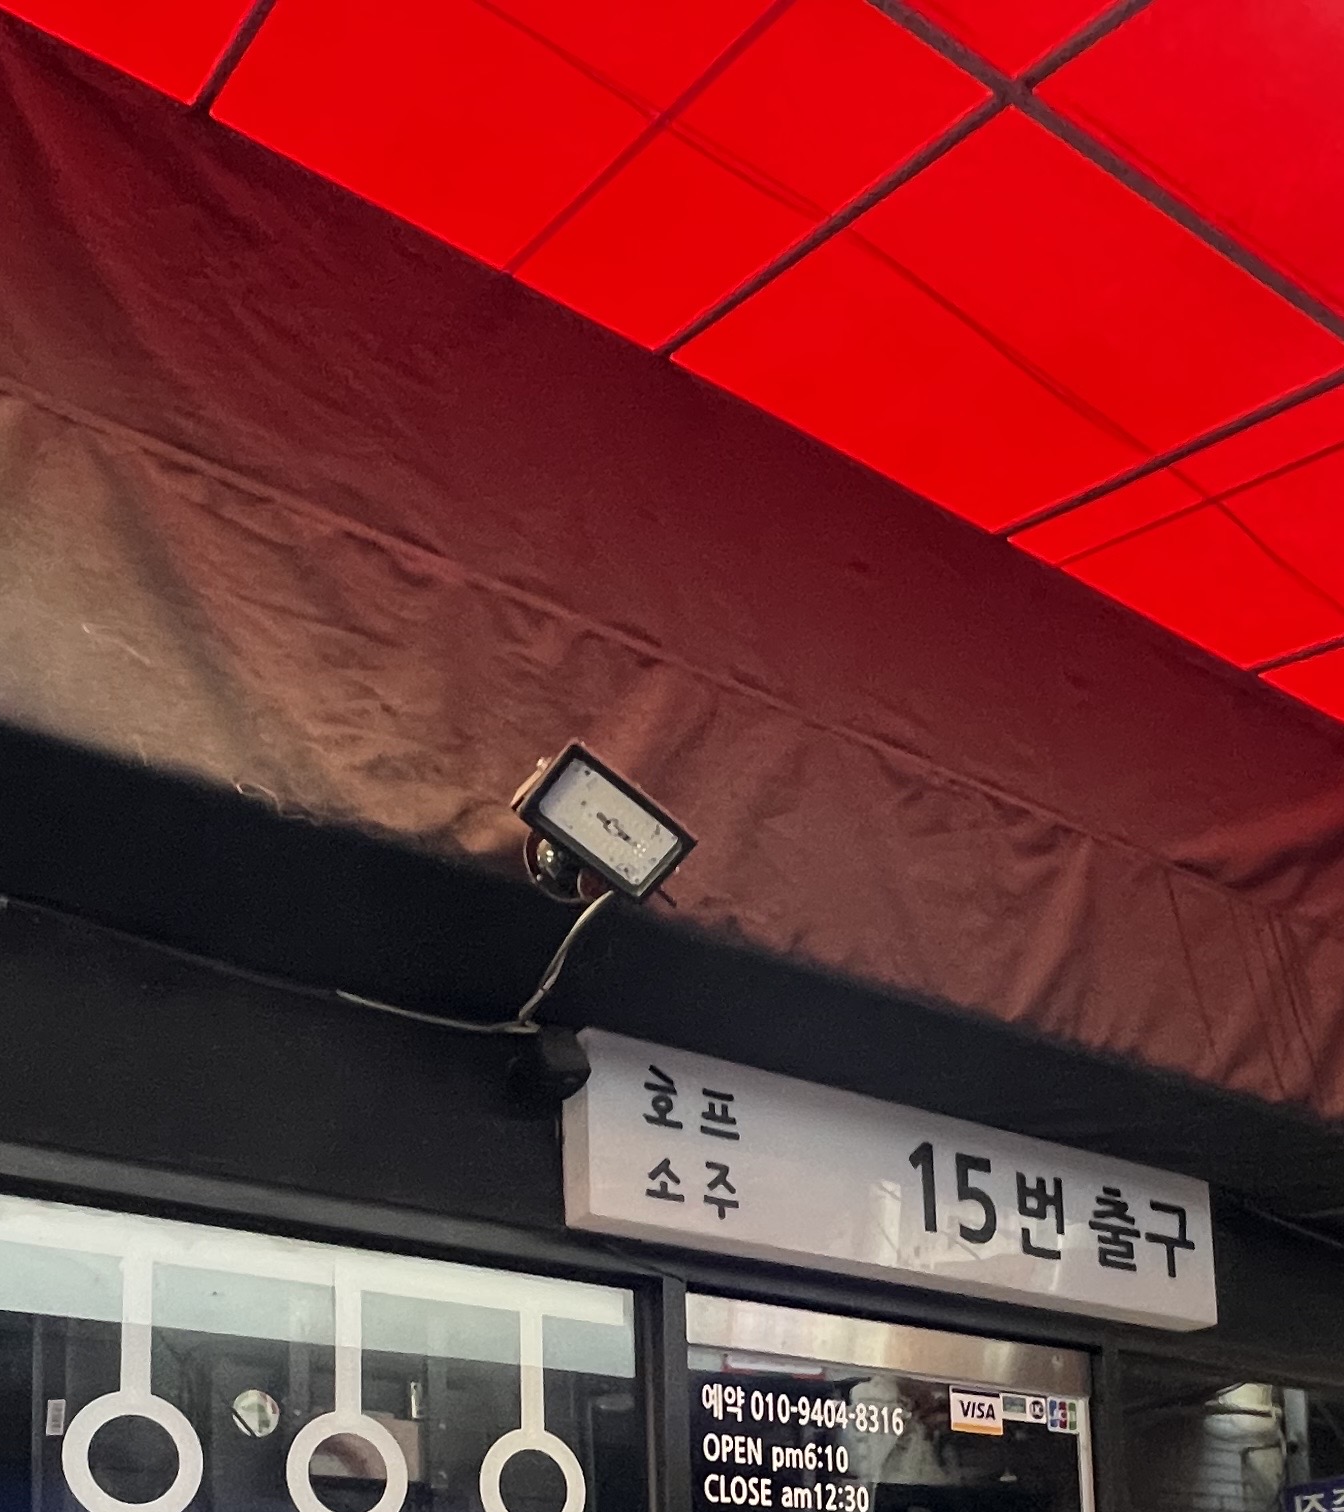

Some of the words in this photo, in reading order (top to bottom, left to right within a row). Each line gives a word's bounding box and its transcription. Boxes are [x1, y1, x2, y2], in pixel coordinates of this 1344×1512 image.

[643, 1065, 740, 1140] 호프
[645, 1157, 740, 1220] 소주
[908, 1141, 1066, 1260] 15번
[1088, 1186, 1196, 1278] 출구
[702, 1384, 745, 1422] 예약
[750, 1391, 904, 1436] 010-9404-8316
[959, 1399, 996, 1420] VISA
[703, 1433, 763, 1466] OPEN
[772, 1442, 849, 1473] pm6:10
[704, 1474, 773, 1507] CLOSE
[781, 1482, 870, 1512] am12:30
